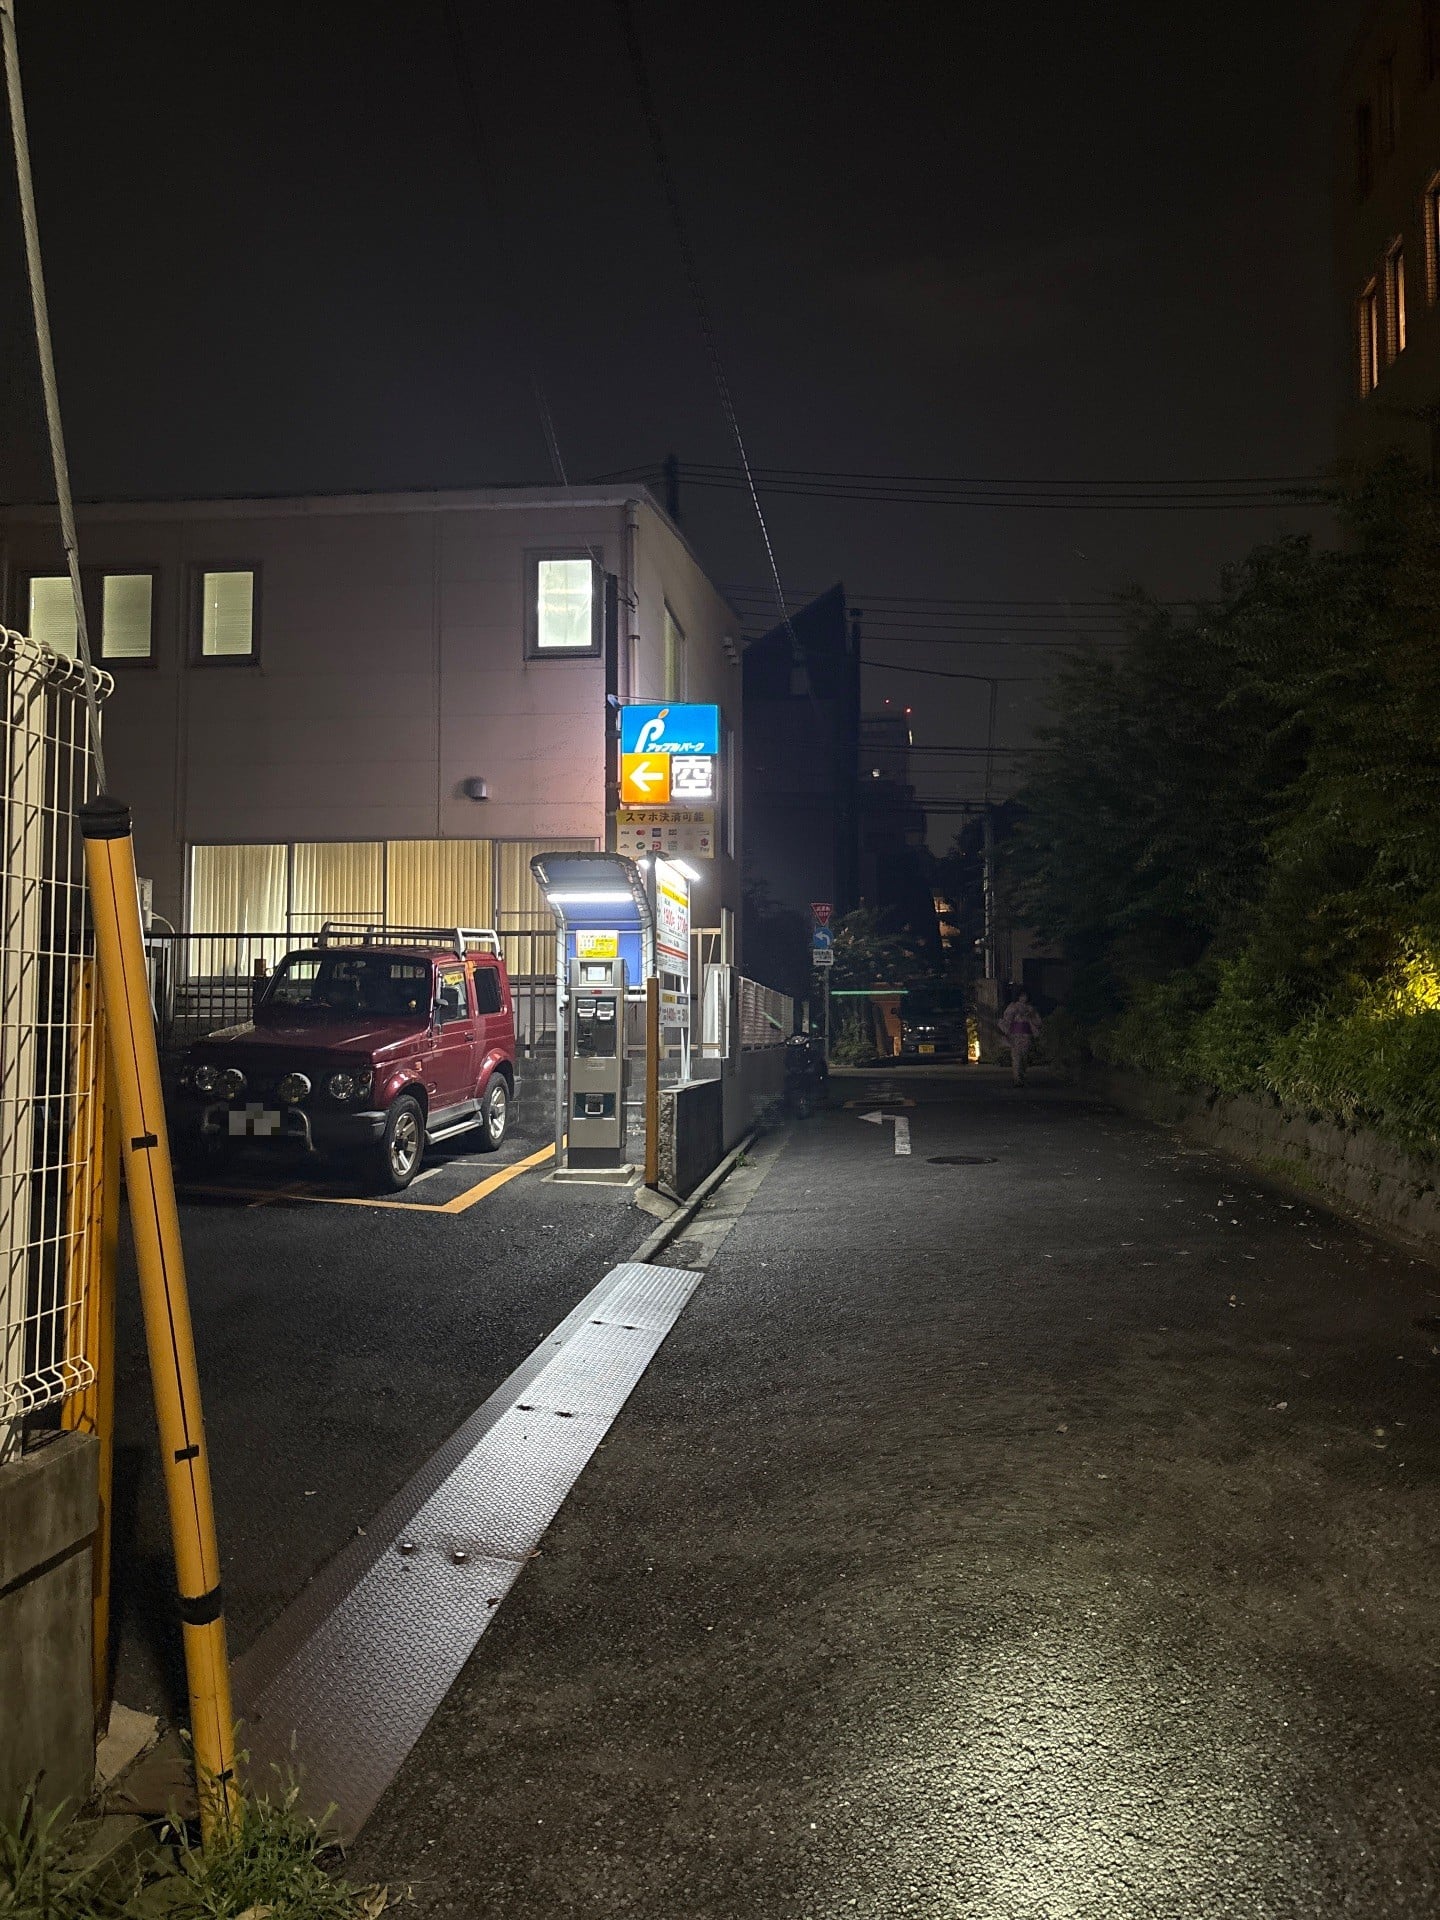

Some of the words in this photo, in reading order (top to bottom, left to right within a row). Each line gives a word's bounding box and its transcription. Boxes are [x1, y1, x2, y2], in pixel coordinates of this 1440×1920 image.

[646, 742, 704, 752] アップルパーク
[671, 755, 712, 797] 空
[626, 812, 704, 822] スマホ決済可能
